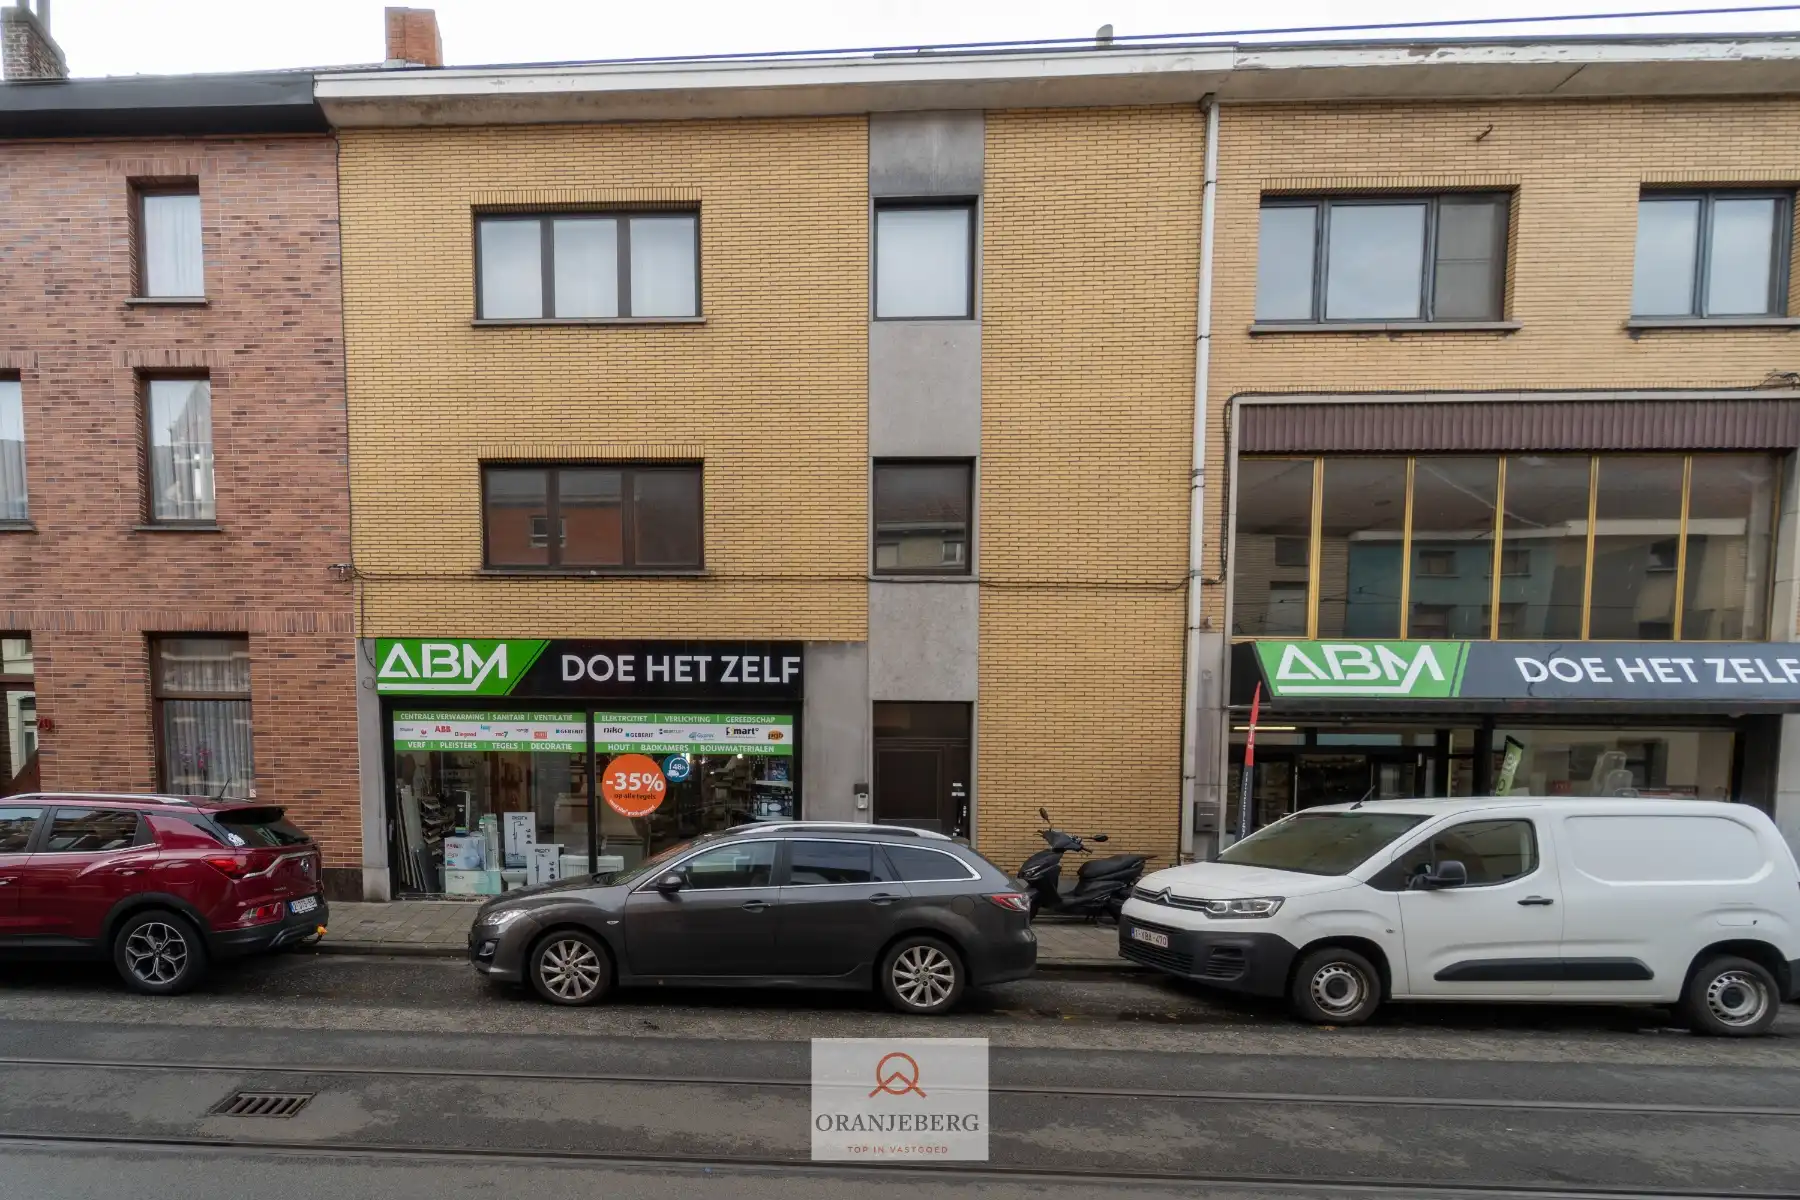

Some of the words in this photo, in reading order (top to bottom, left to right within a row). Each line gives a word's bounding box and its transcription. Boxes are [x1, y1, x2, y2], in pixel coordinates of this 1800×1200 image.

[377, 643, 508, 691] ABM
[562, 654, 635, 682] DOE
[647, 655, 712, 682] HET
[720, 656, 800, 683] ZELF
[1276, 645, 1445, 693] ABM
[1515, 657, 1613, 683] DOE
[1616, 658, 1698, 683] HET
[1704, 658, 1800, 684] ZELF
[436, 713, 484, 721] VERWARMING
[664, 715, 711, 723] VERLICHTING
[434, 725, 452, 733] ABB
[603, 726, 623, 734] niko
[408, 741, 426, 749] VERF
[440, 741, 477, 749] PLEISTERS
[531, 742, 572, 750] DECORATIE
[608, 743, 629, 751] HOUT
[640, 744, 688, 752] BADKAMERS
[700, 744, 775, 752] BOUWMATERIALEN
[606, 772, 664, 792] -35%
